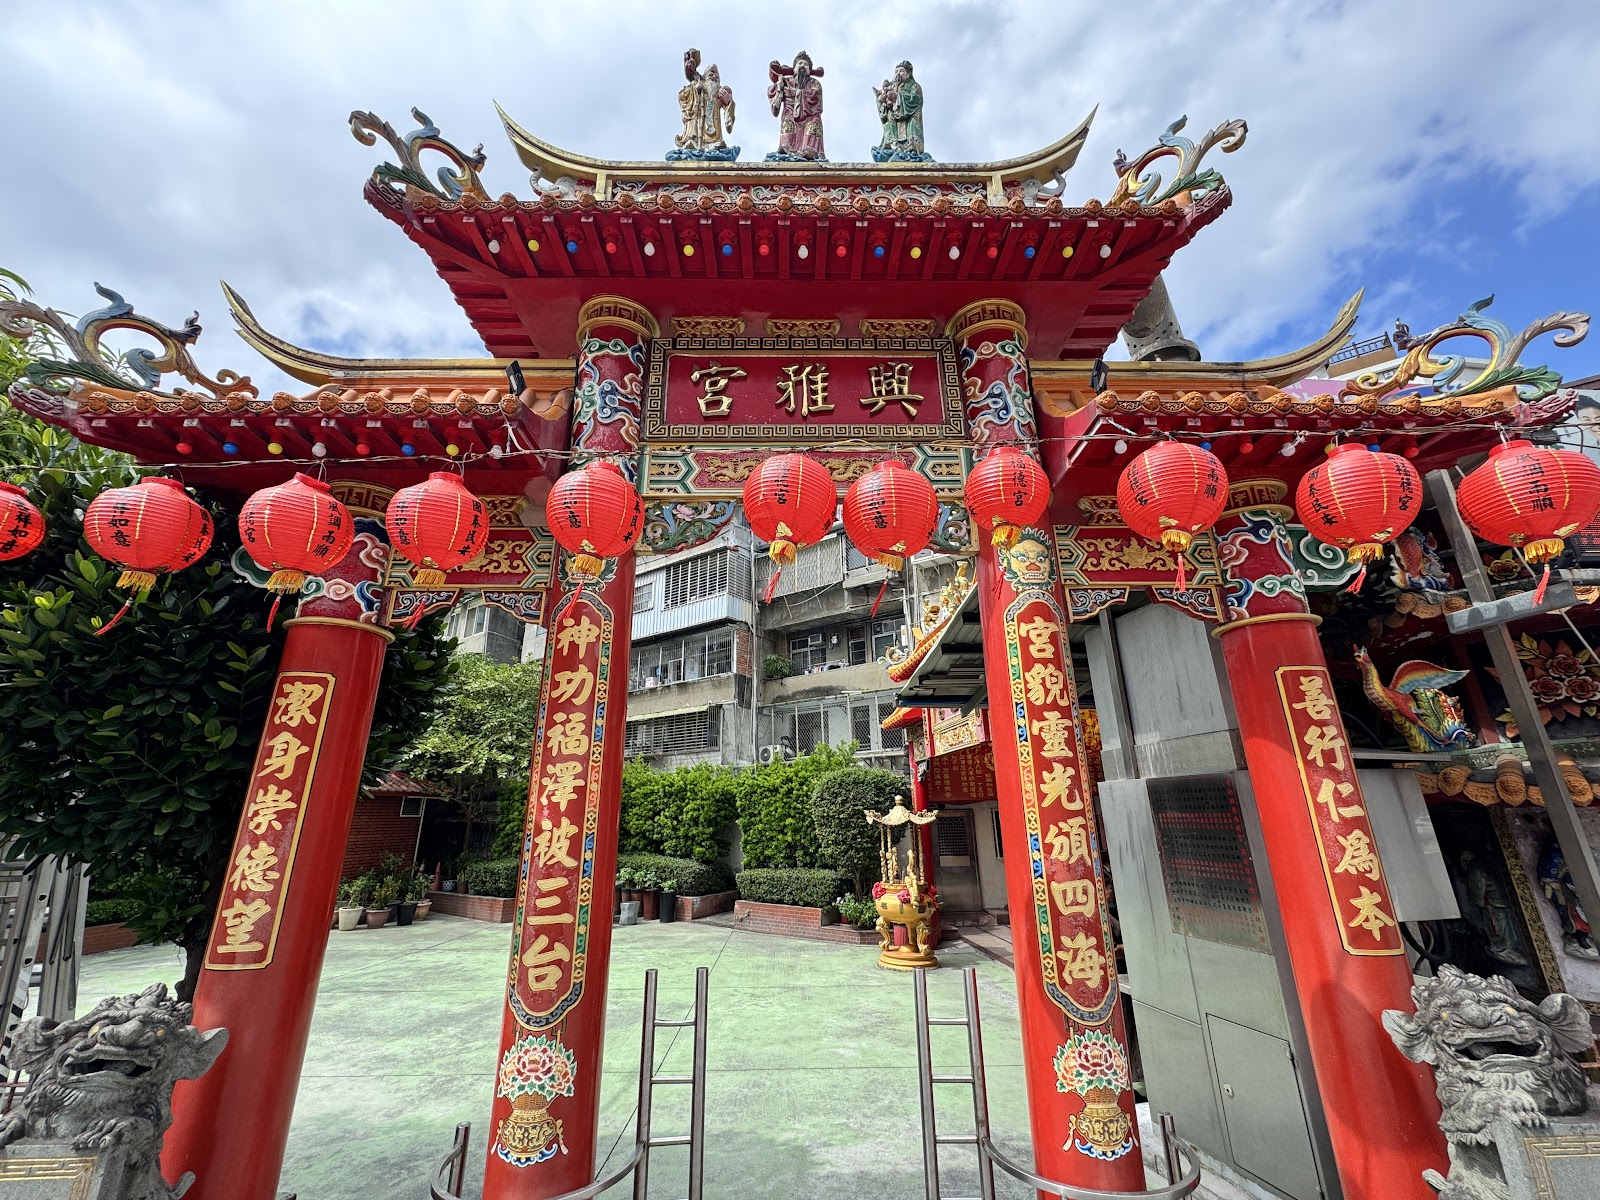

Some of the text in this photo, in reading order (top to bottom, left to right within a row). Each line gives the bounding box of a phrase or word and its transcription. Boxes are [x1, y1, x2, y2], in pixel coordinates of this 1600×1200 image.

[562, 476, 582, 529] 祥如意
[1010, 458, 1028, 507] 福德宮
[107, 490, 132, 547] 祥如意
[312, 501, 343, 560] 風調雨順
[216, 681, 325, 954] 潔身崇德望
[521, 614, 600, 992] 神功福澤被三台
